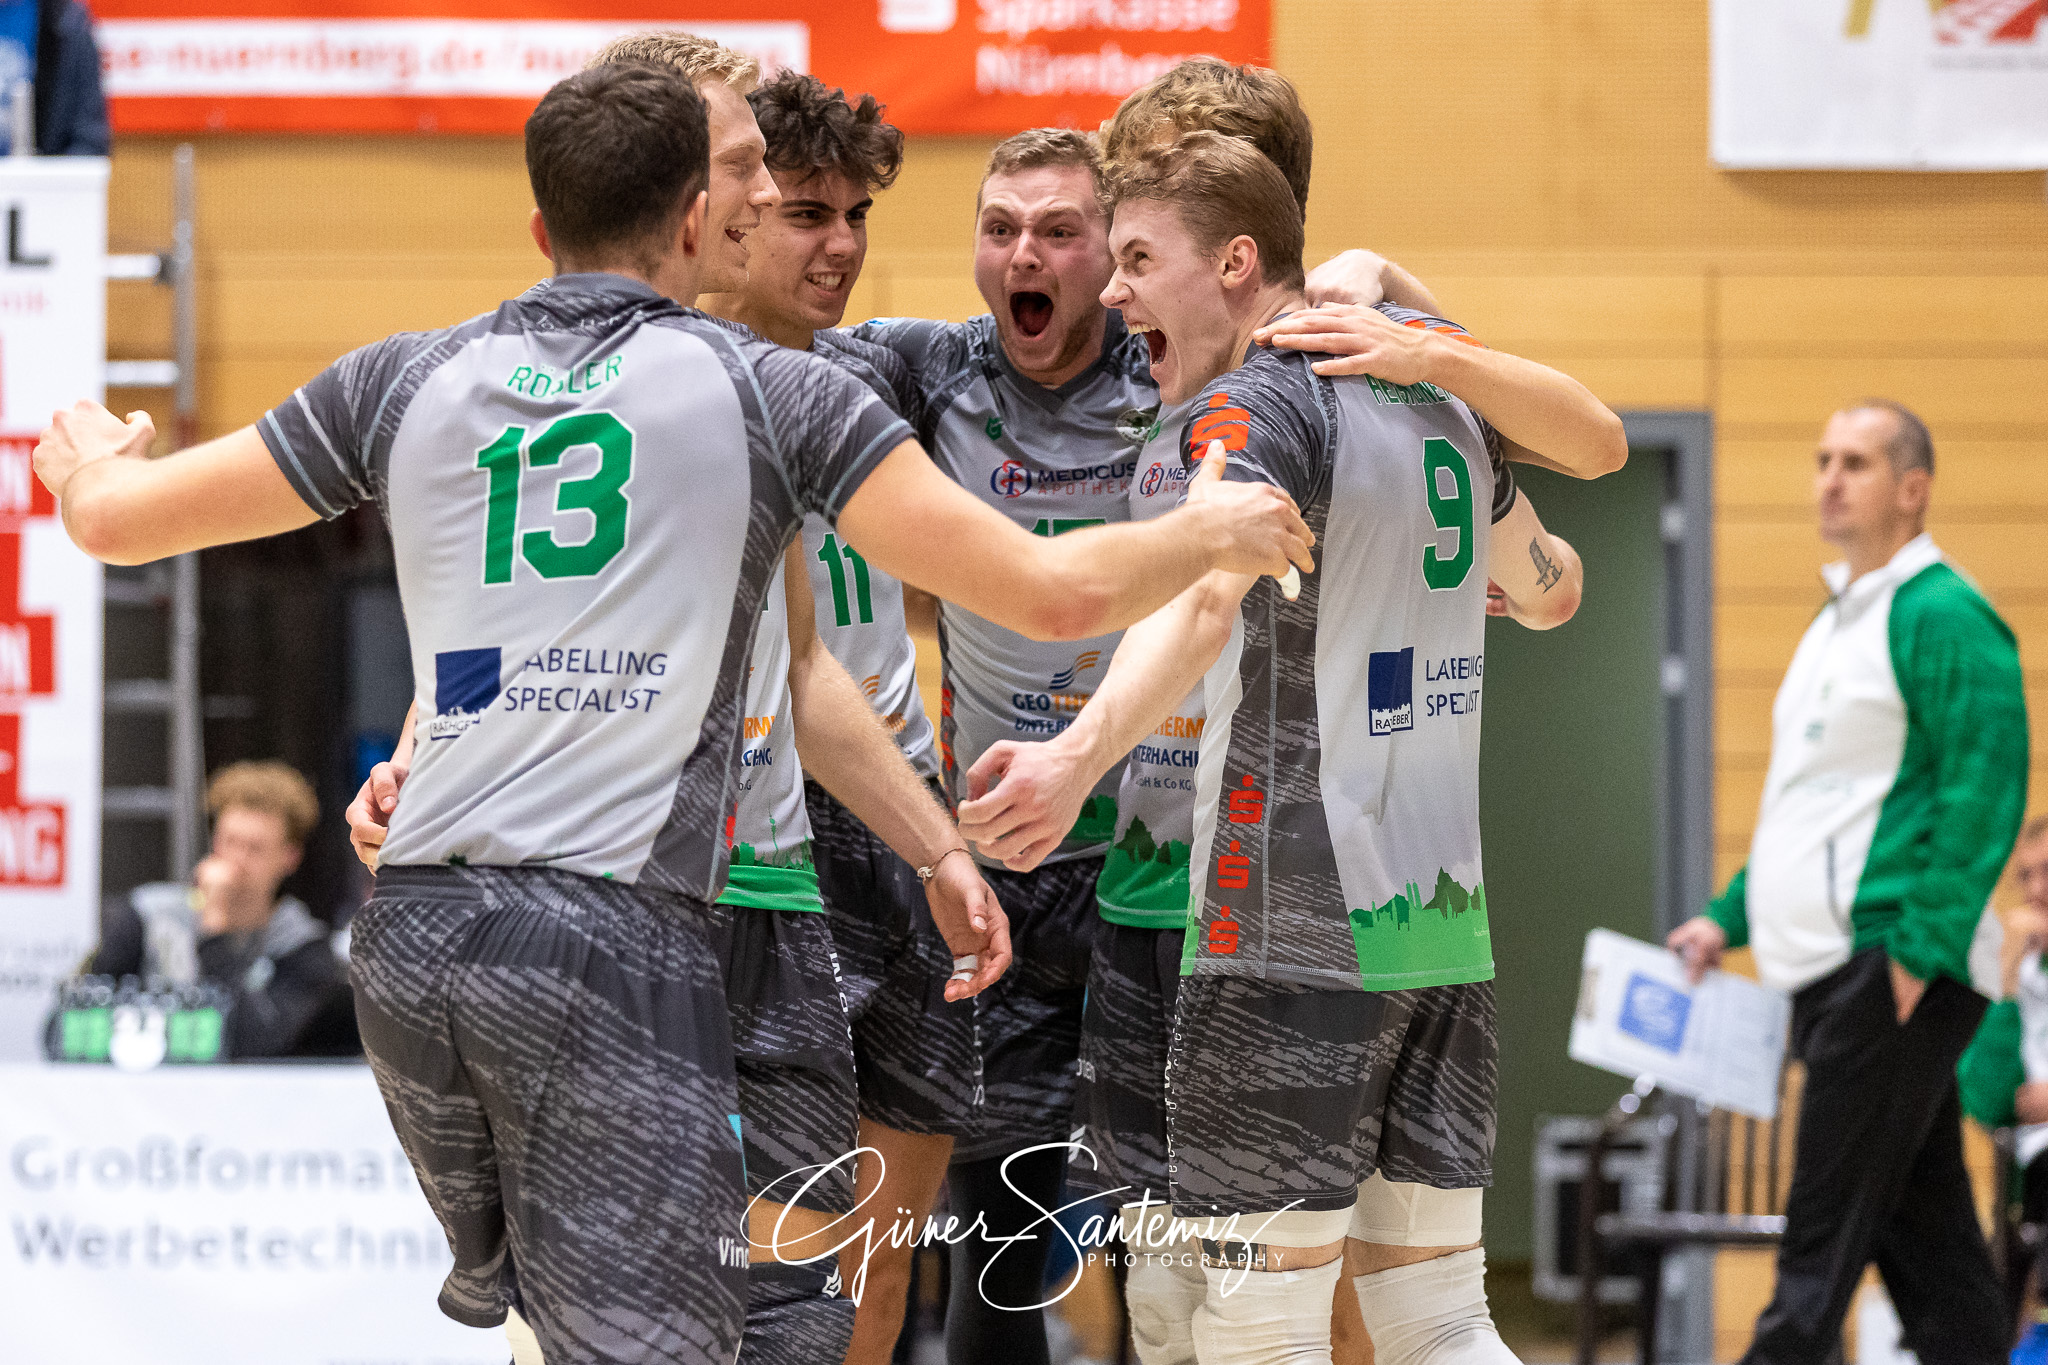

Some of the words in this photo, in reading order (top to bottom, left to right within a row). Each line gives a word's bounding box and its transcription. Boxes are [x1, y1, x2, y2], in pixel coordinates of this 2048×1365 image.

[1037, 462, 1137, 483] MEDICUS
[474, 409, 636, 588] 13
[1038, 481, 1129, 495] APOTHEK
[1422, 436, 1475, 592] 9
[817, 532, 874, 628] 11
[524, 648, 668, 676] ABELLING
[505, 686, 661, 713] SPECIALIST
[1012, 692, 1090, 712] GEOTHE
[10, 1212, 450, 1270] Werbetechni
